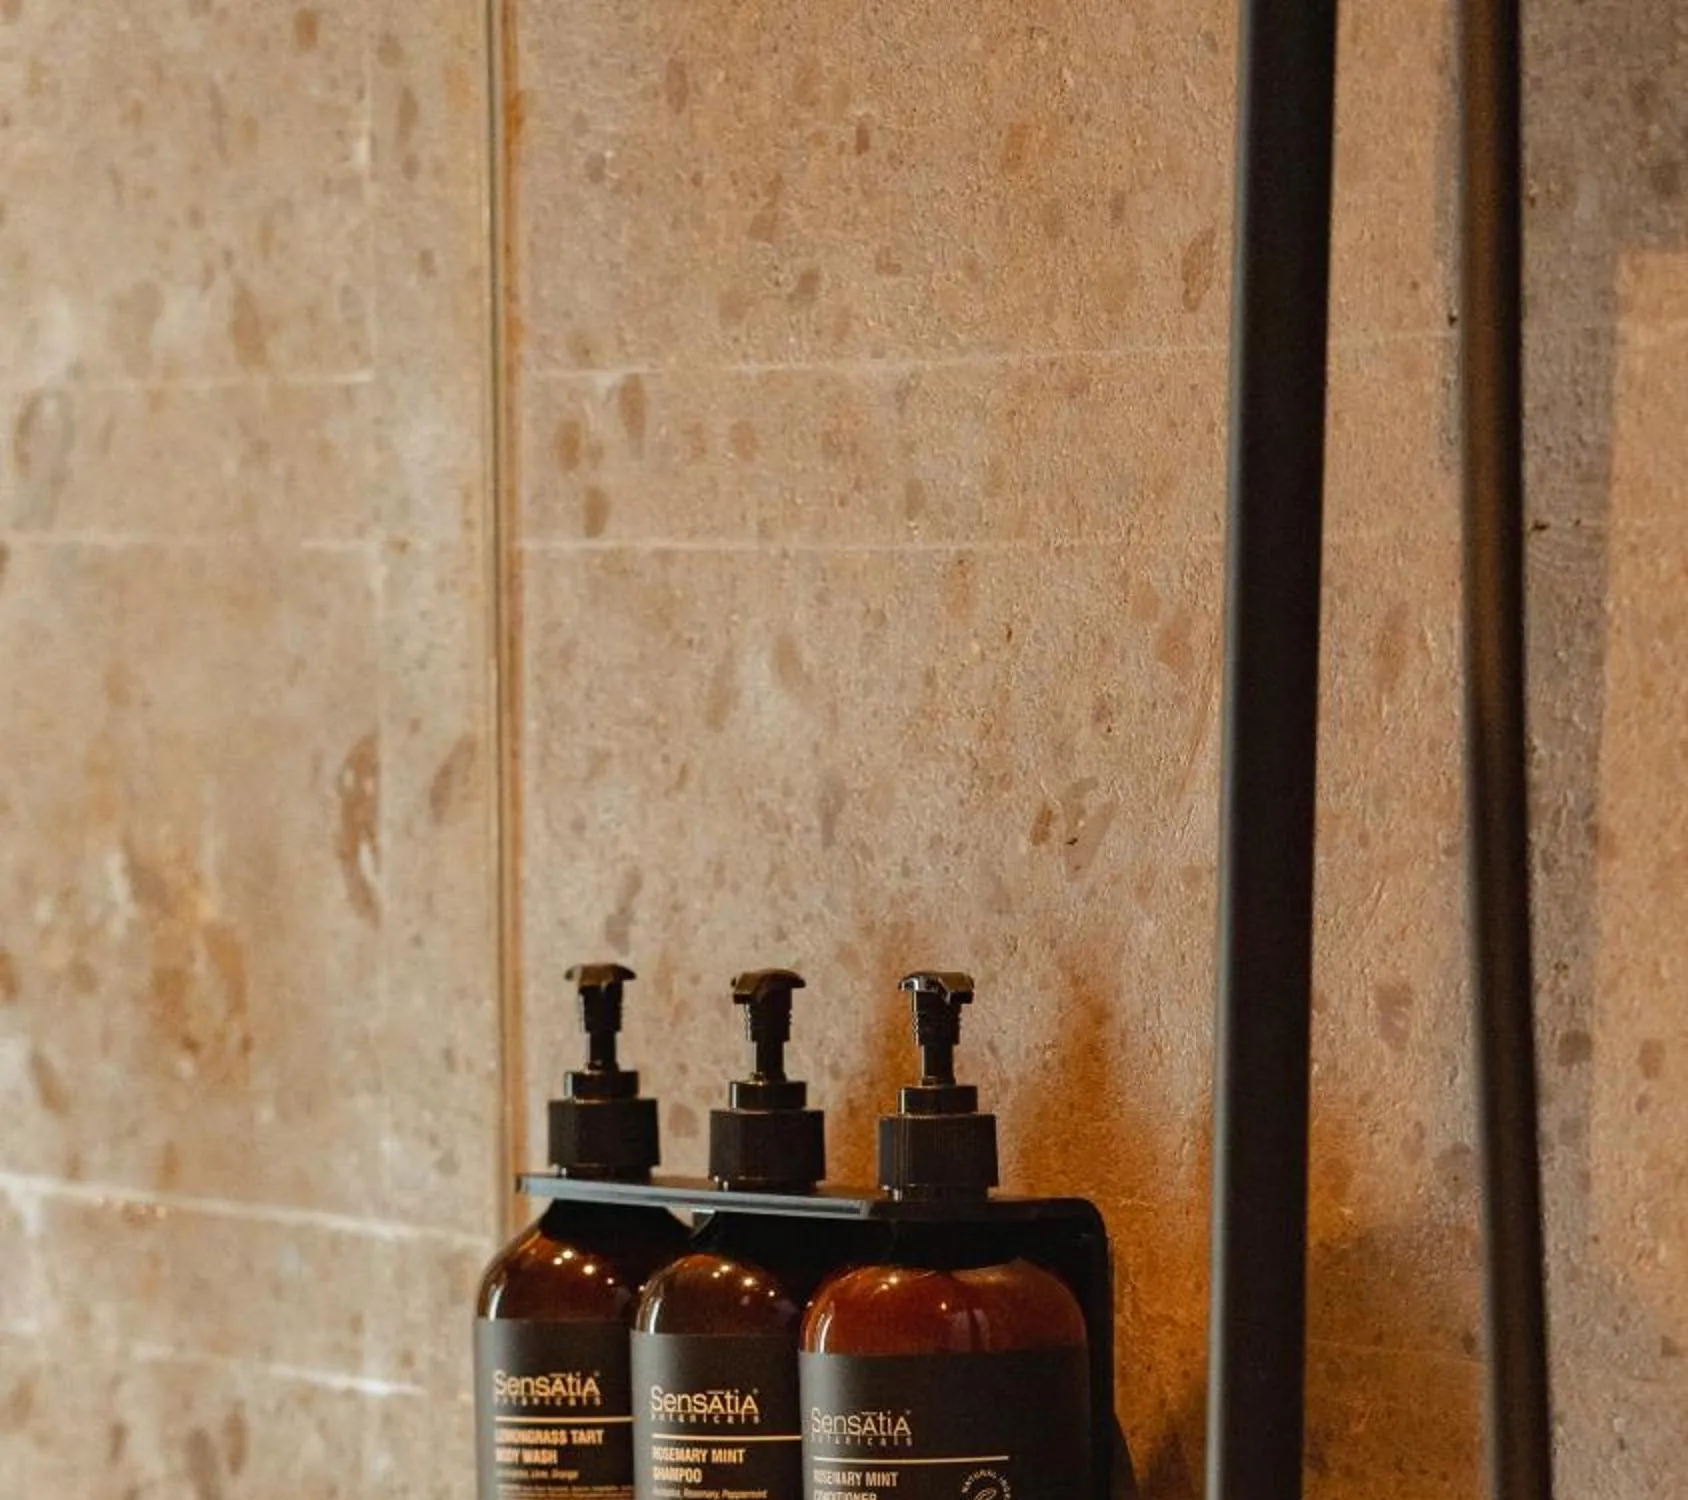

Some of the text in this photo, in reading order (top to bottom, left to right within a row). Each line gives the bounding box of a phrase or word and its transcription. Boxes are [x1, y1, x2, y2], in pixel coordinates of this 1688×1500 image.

[570, 1429, 604, 1445] TART
[711, 1448, 746, 1464] MINT
[653, 1467, 703, 1483] SHAMPOO
[865, 1471, 899, 1488] MINT
